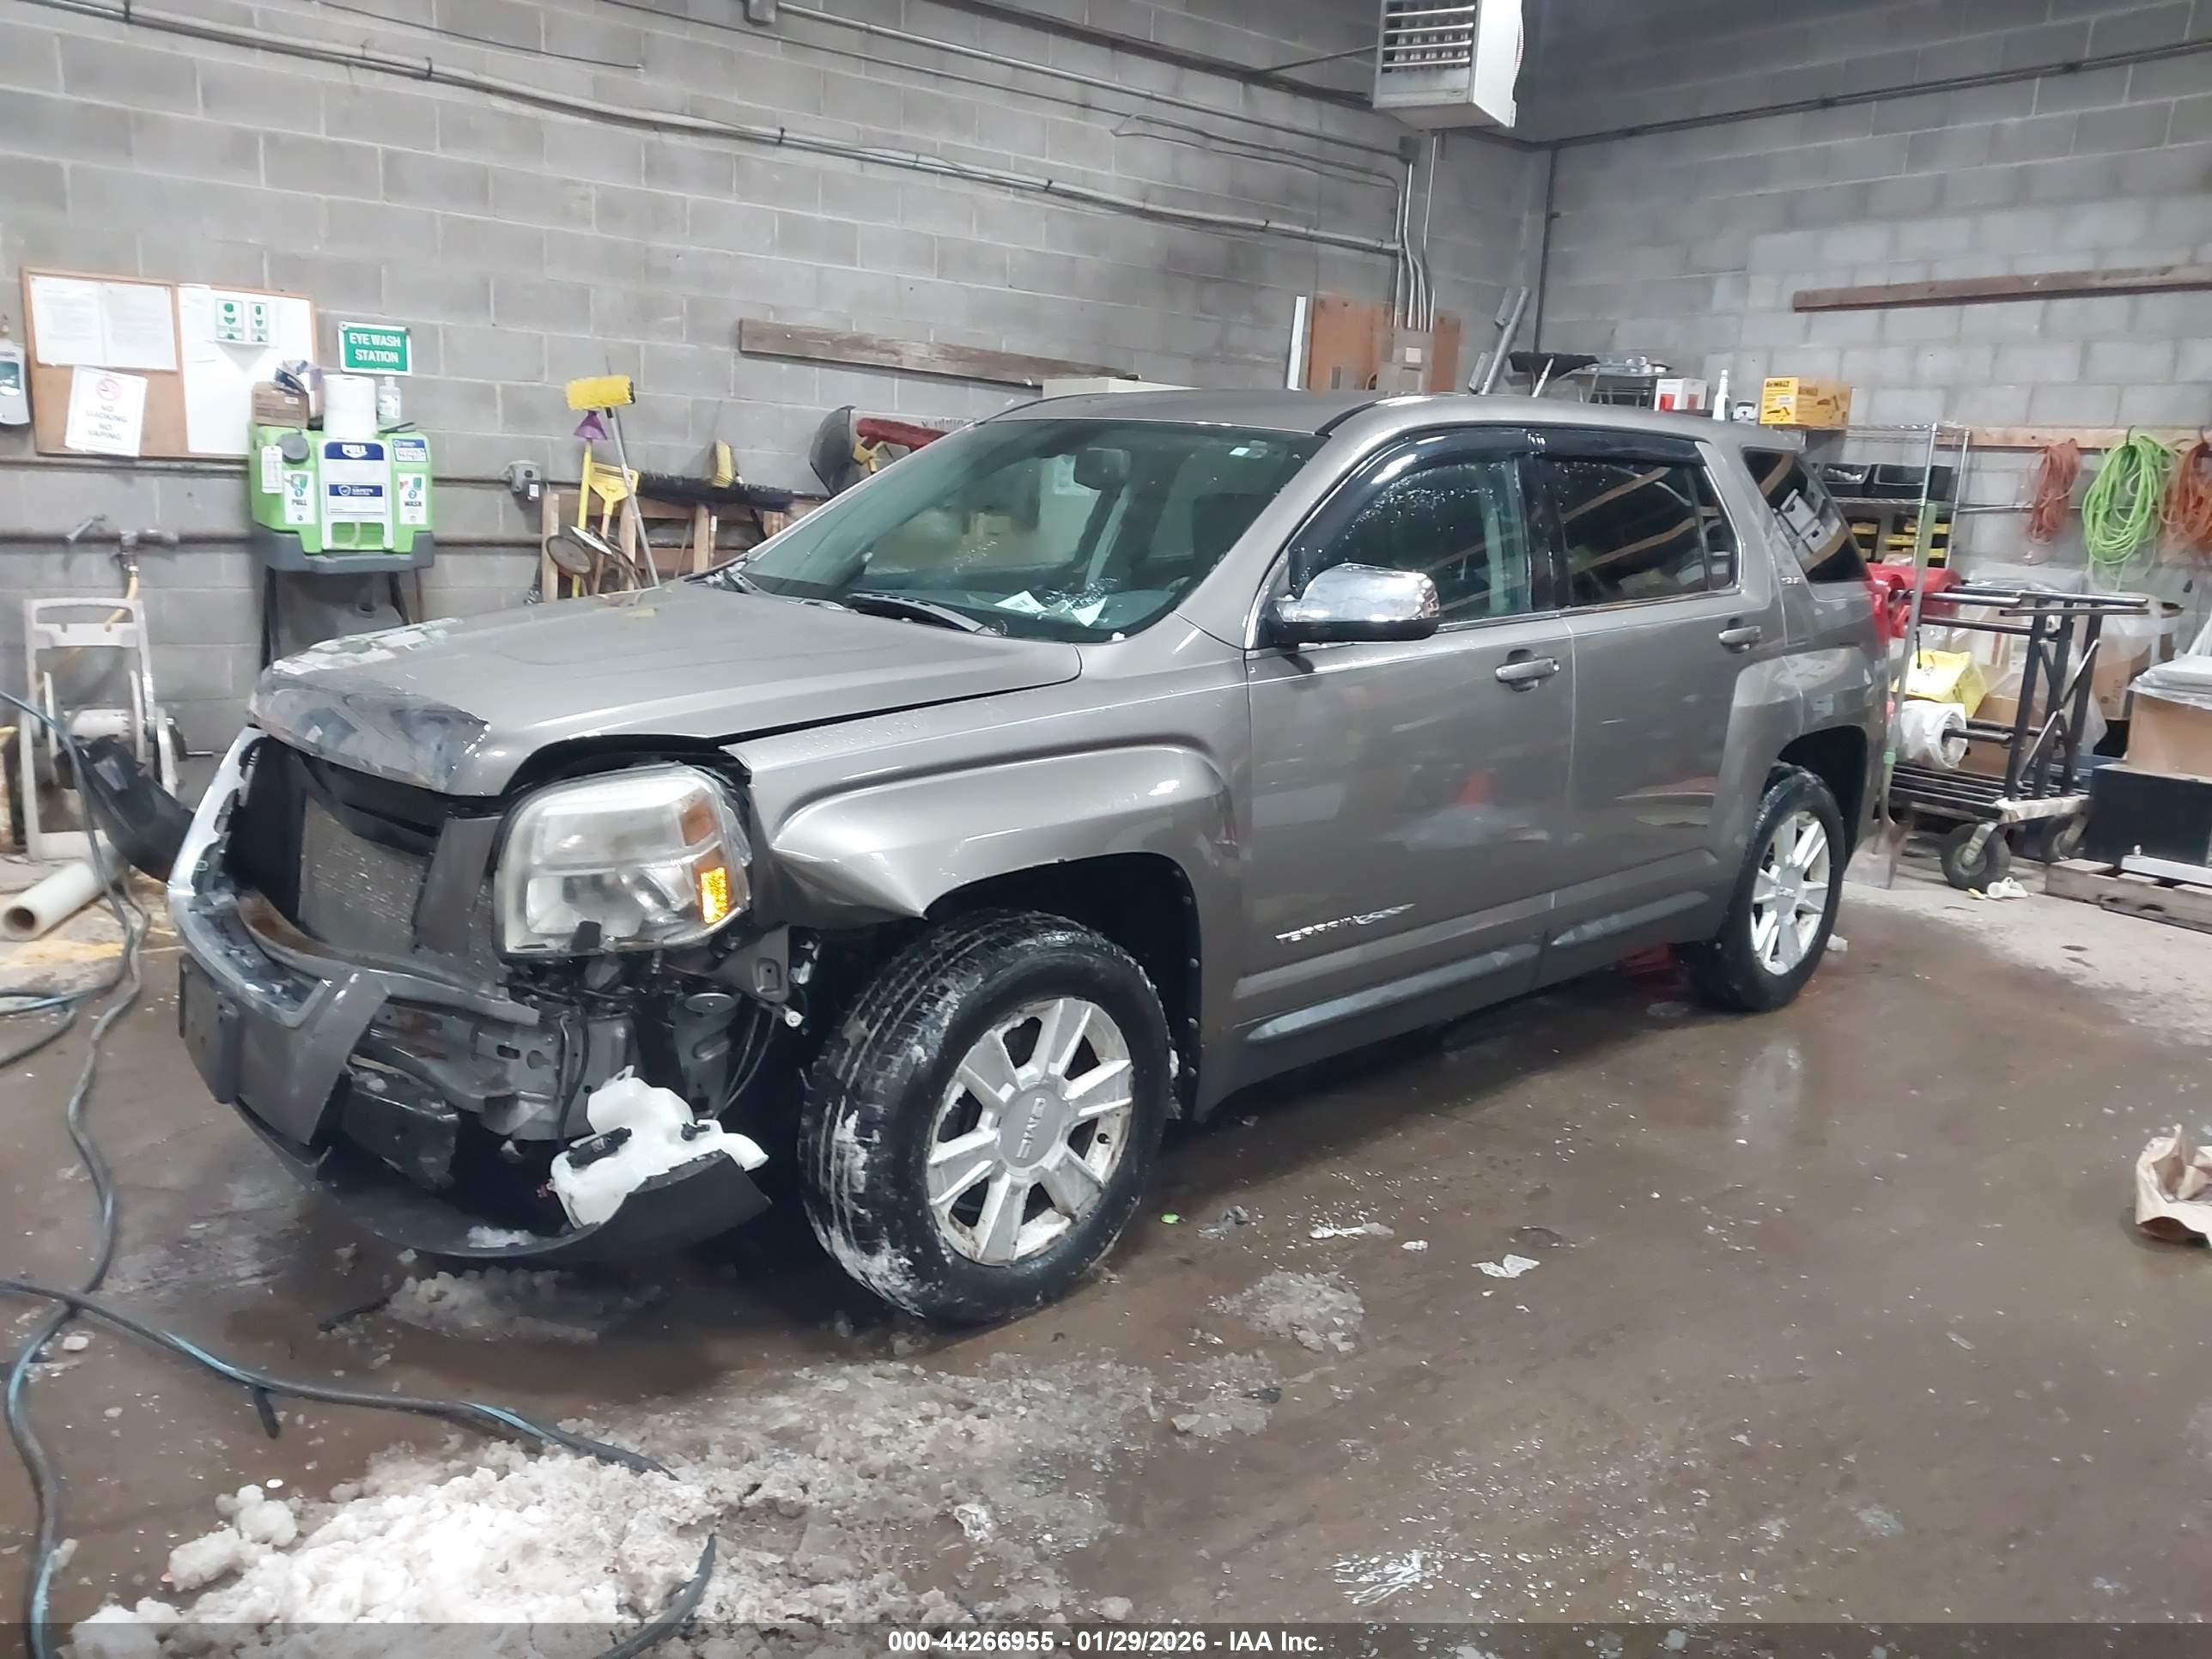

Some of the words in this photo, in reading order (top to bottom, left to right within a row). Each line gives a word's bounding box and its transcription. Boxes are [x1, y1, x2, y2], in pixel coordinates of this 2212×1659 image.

[349, 331, 371, 345] EYE
[370, 333, 402, 348] WASH
[354, 348, 399, 364] STATION
